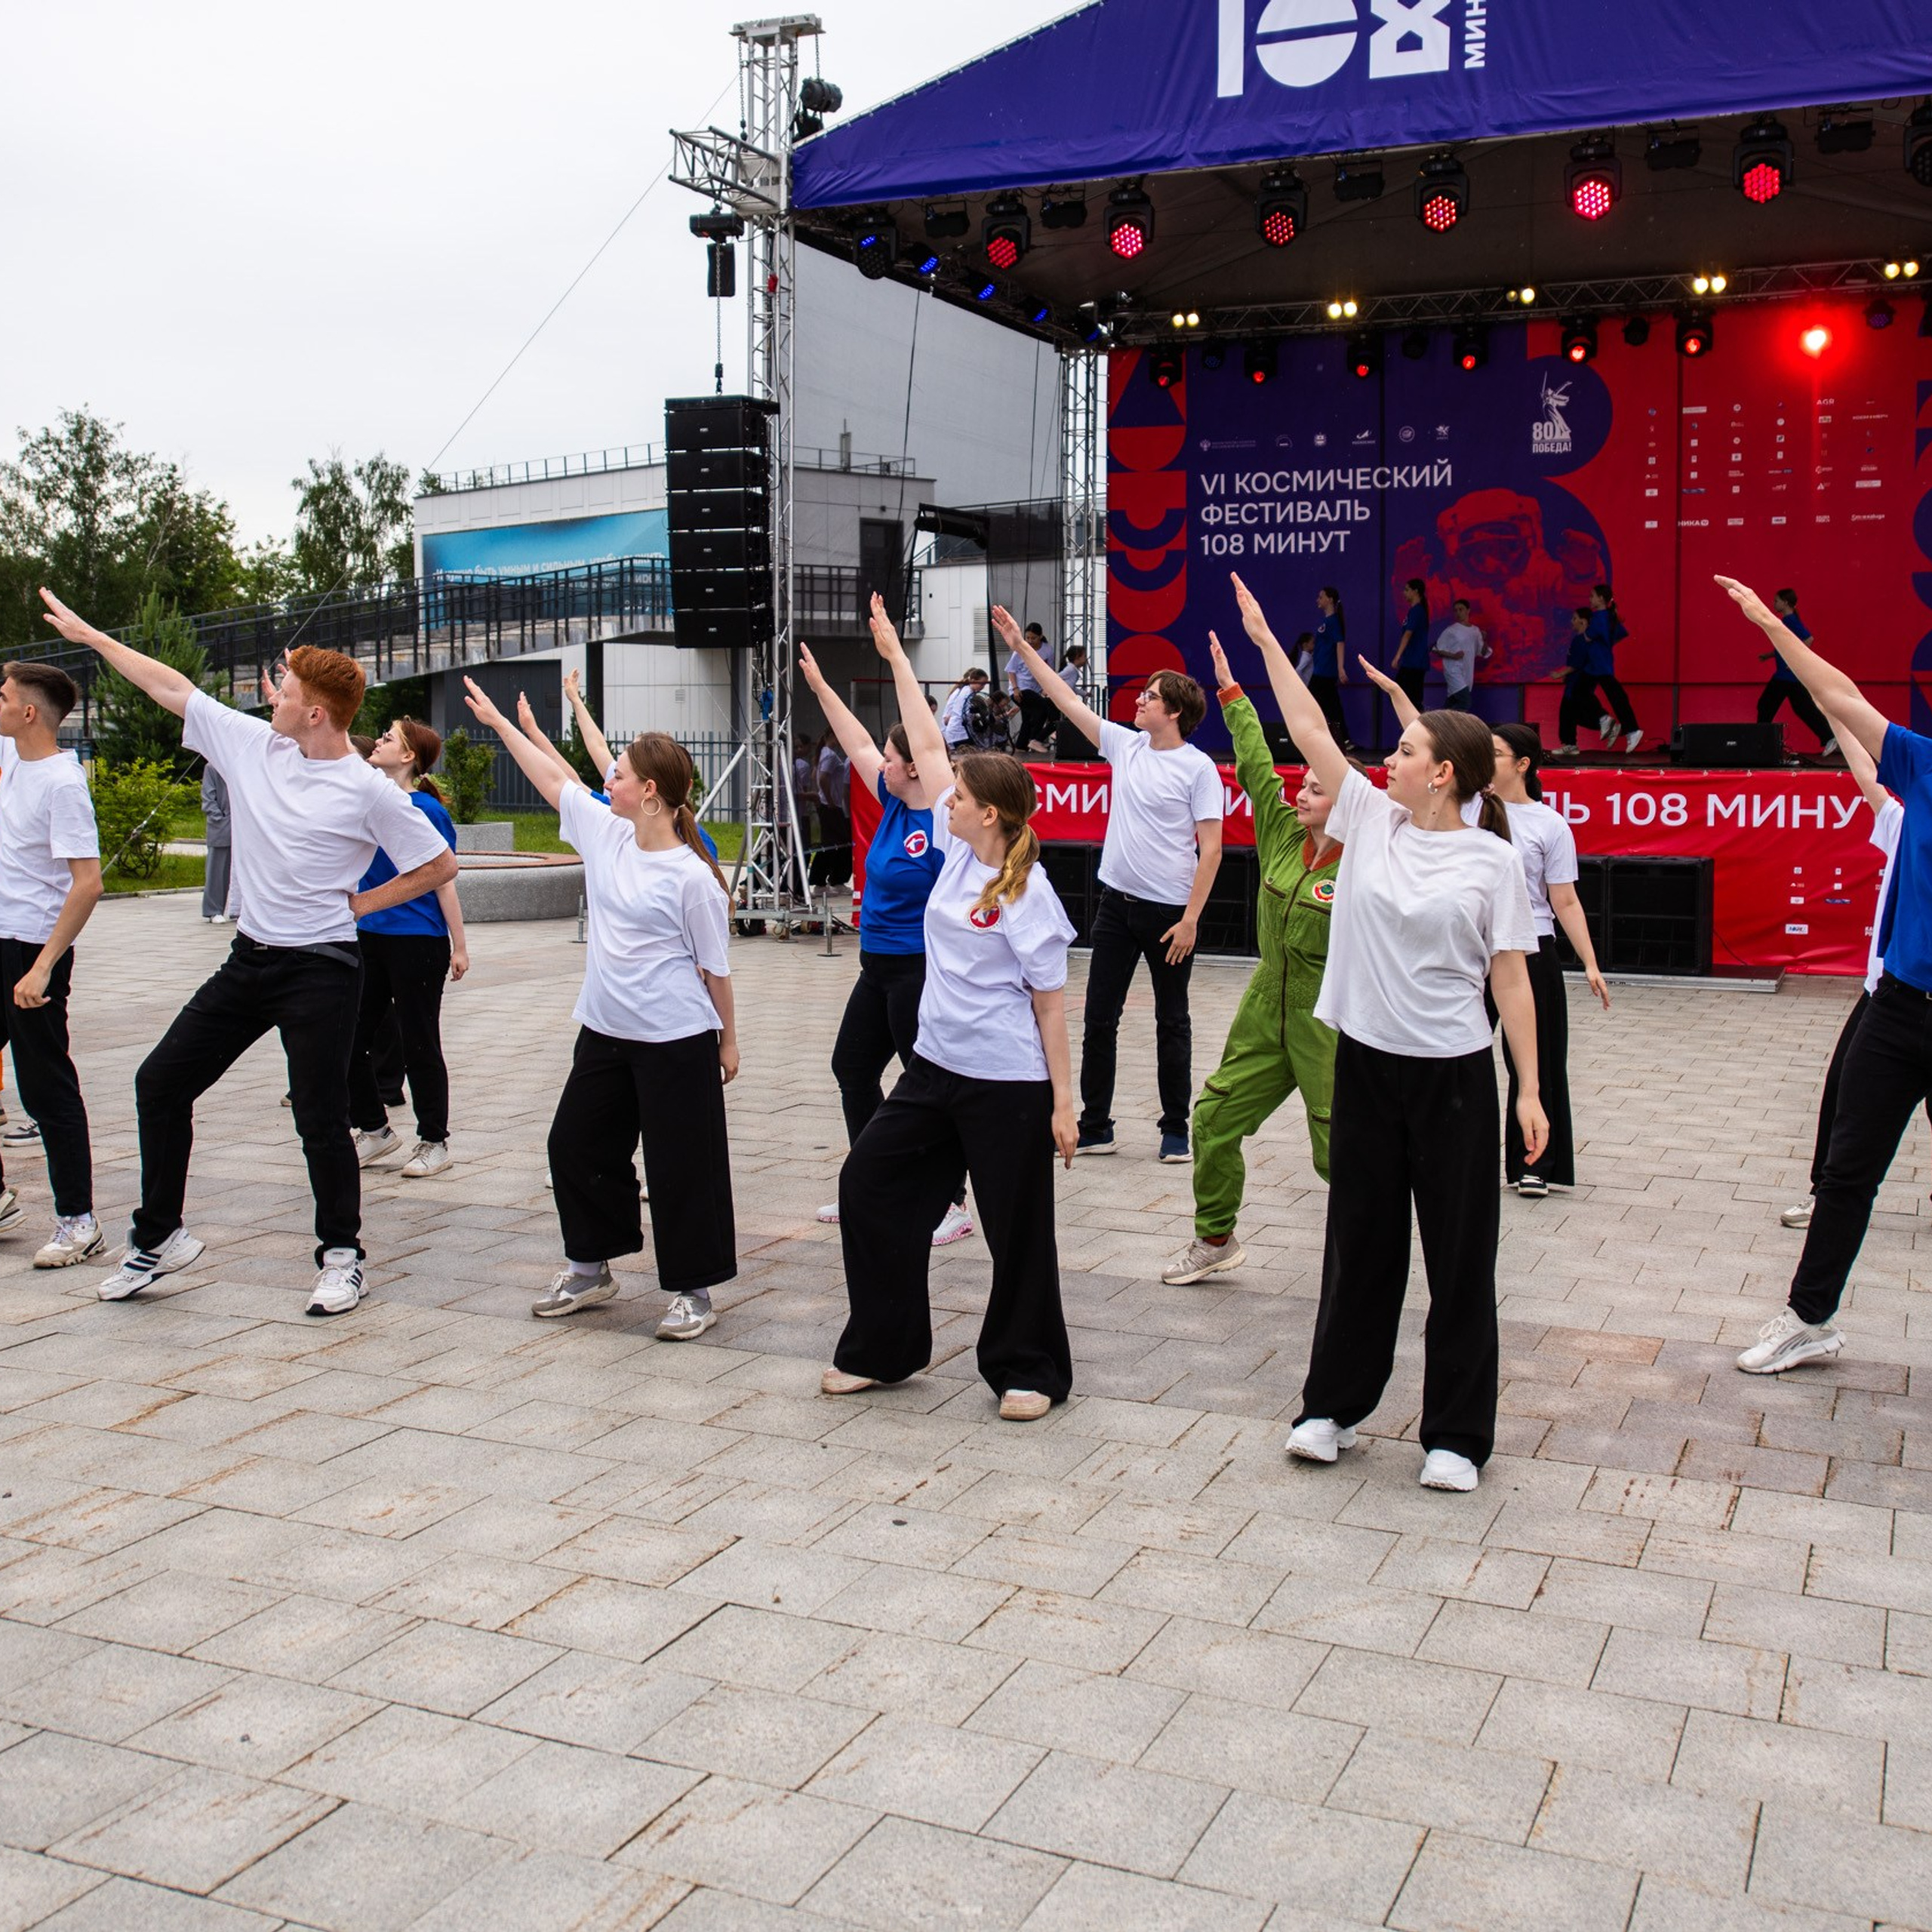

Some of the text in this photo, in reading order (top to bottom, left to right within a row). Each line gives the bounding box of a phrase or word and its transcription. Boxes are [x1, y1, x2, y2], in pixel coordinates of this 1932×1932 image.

[1533, 421, 1554, 441] 80
[1533, 442, 1572, 454] ПОБЕДА!
[1200, 458, 1453, 495] VI КОСМИЧЕСКИЙ
[1200, 499, 1371, 526] ФЕСТИВАЛЬ
[1201, 531, 1351, 555] 108 МИНУТ
[1605, 792, 1688, 826] 108
[1707, 794, 1869, 829] МИНУ
